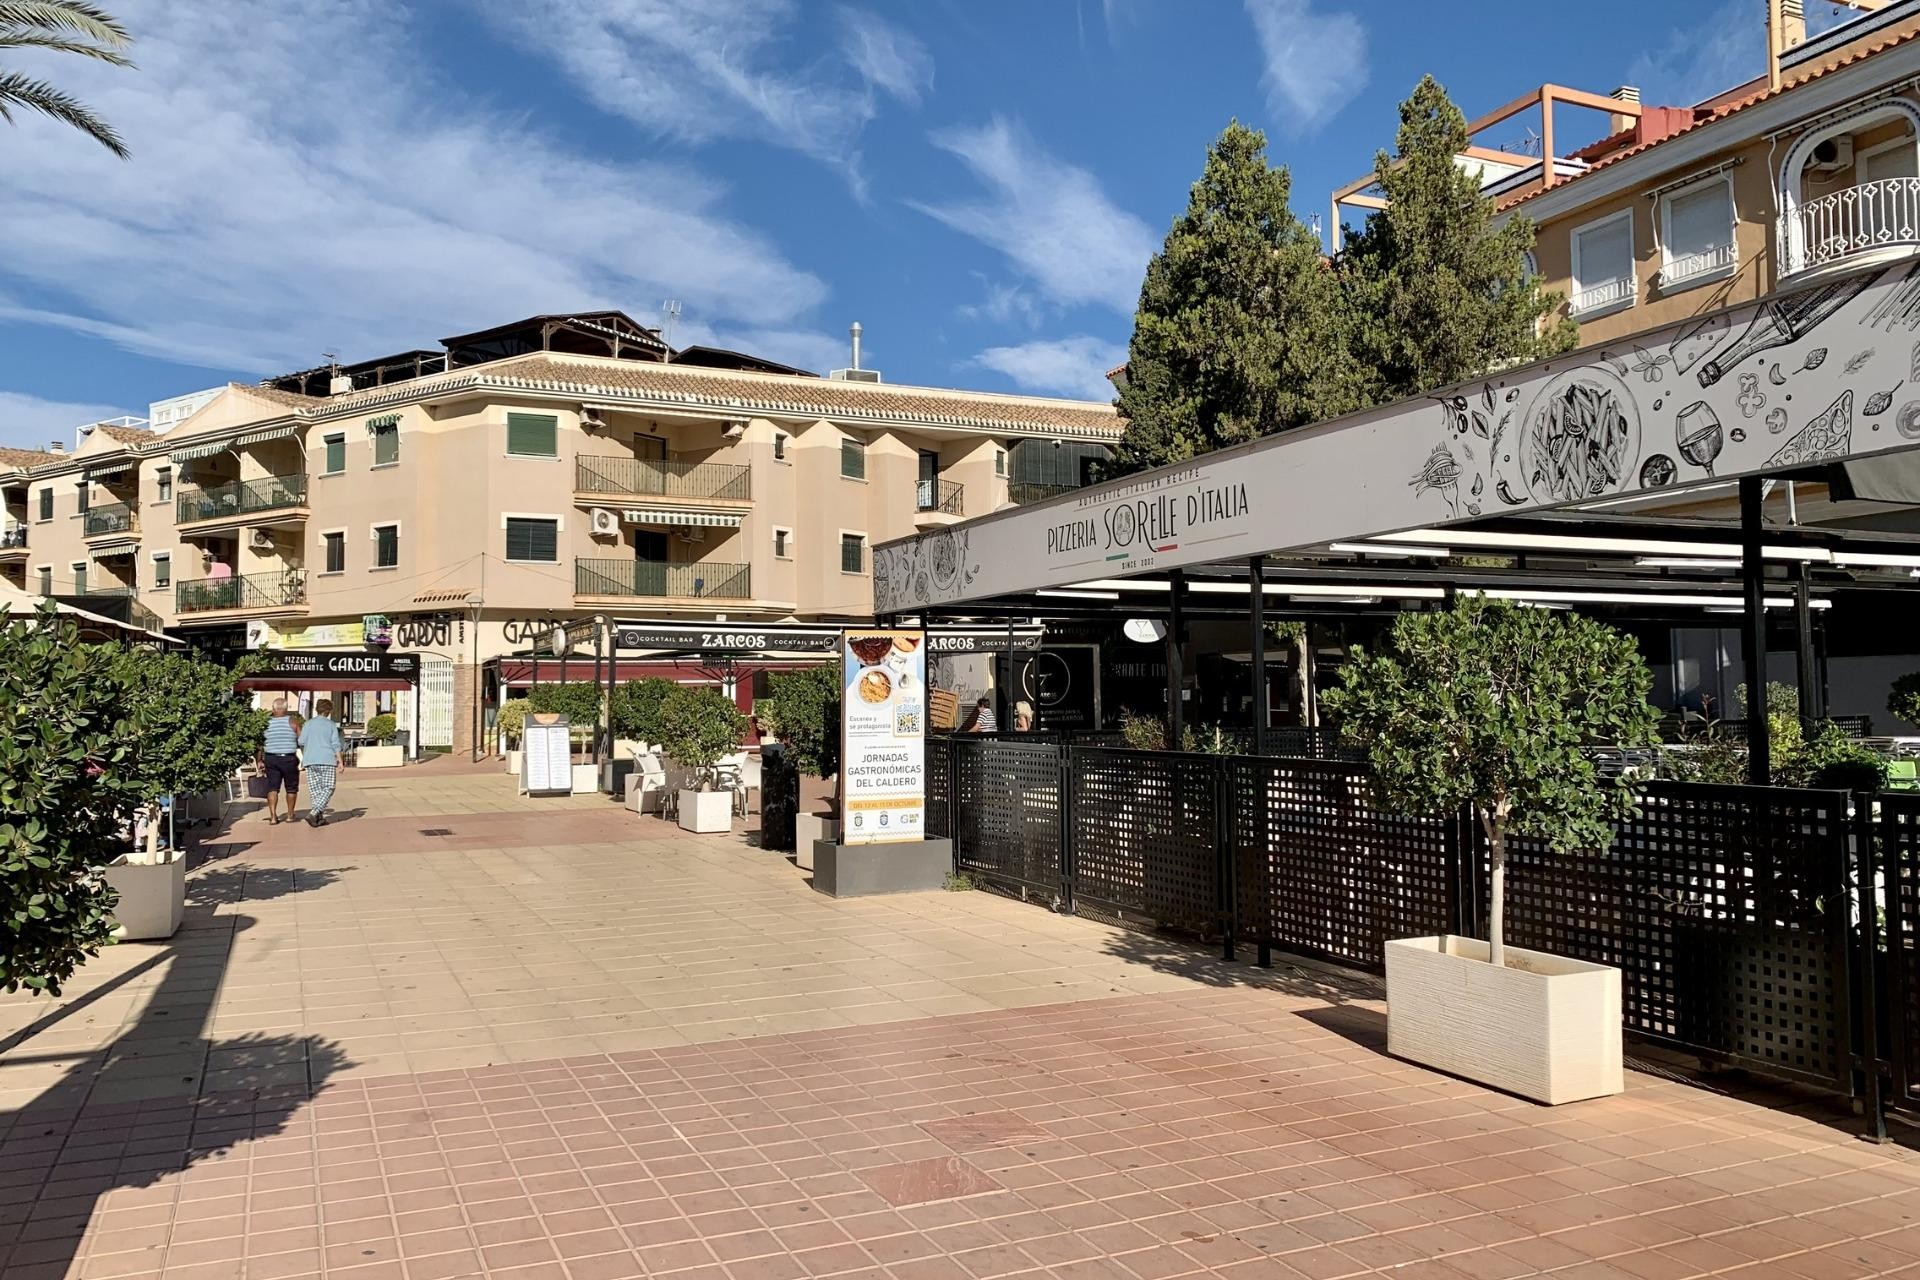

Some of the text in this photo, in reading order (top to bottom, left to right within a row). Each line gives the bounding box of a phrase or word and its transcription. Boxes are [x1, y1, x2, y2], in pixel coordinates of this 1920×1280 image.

[1079, 468, 1200, 507] AUTHENTIC ITALIAN RECIPE
[1047, 482, 1249, 555] PIZZERIA SORELLE D'ITALIA
[1121, 560, 1137, 570] SINCE
[701, 634, 766, 649] ZARCOS
[927, 637, 975, 650] ARCOS
[284, 656, 316, 664] PIZZERIA
[328, 657, 380, 673] GARDEN
[861, 753, 909, 763] JORNADAS
[848, 764, 922, 776] GASTRONÓMICAS
[856, 777, 917, 788] DEL CALDERO
